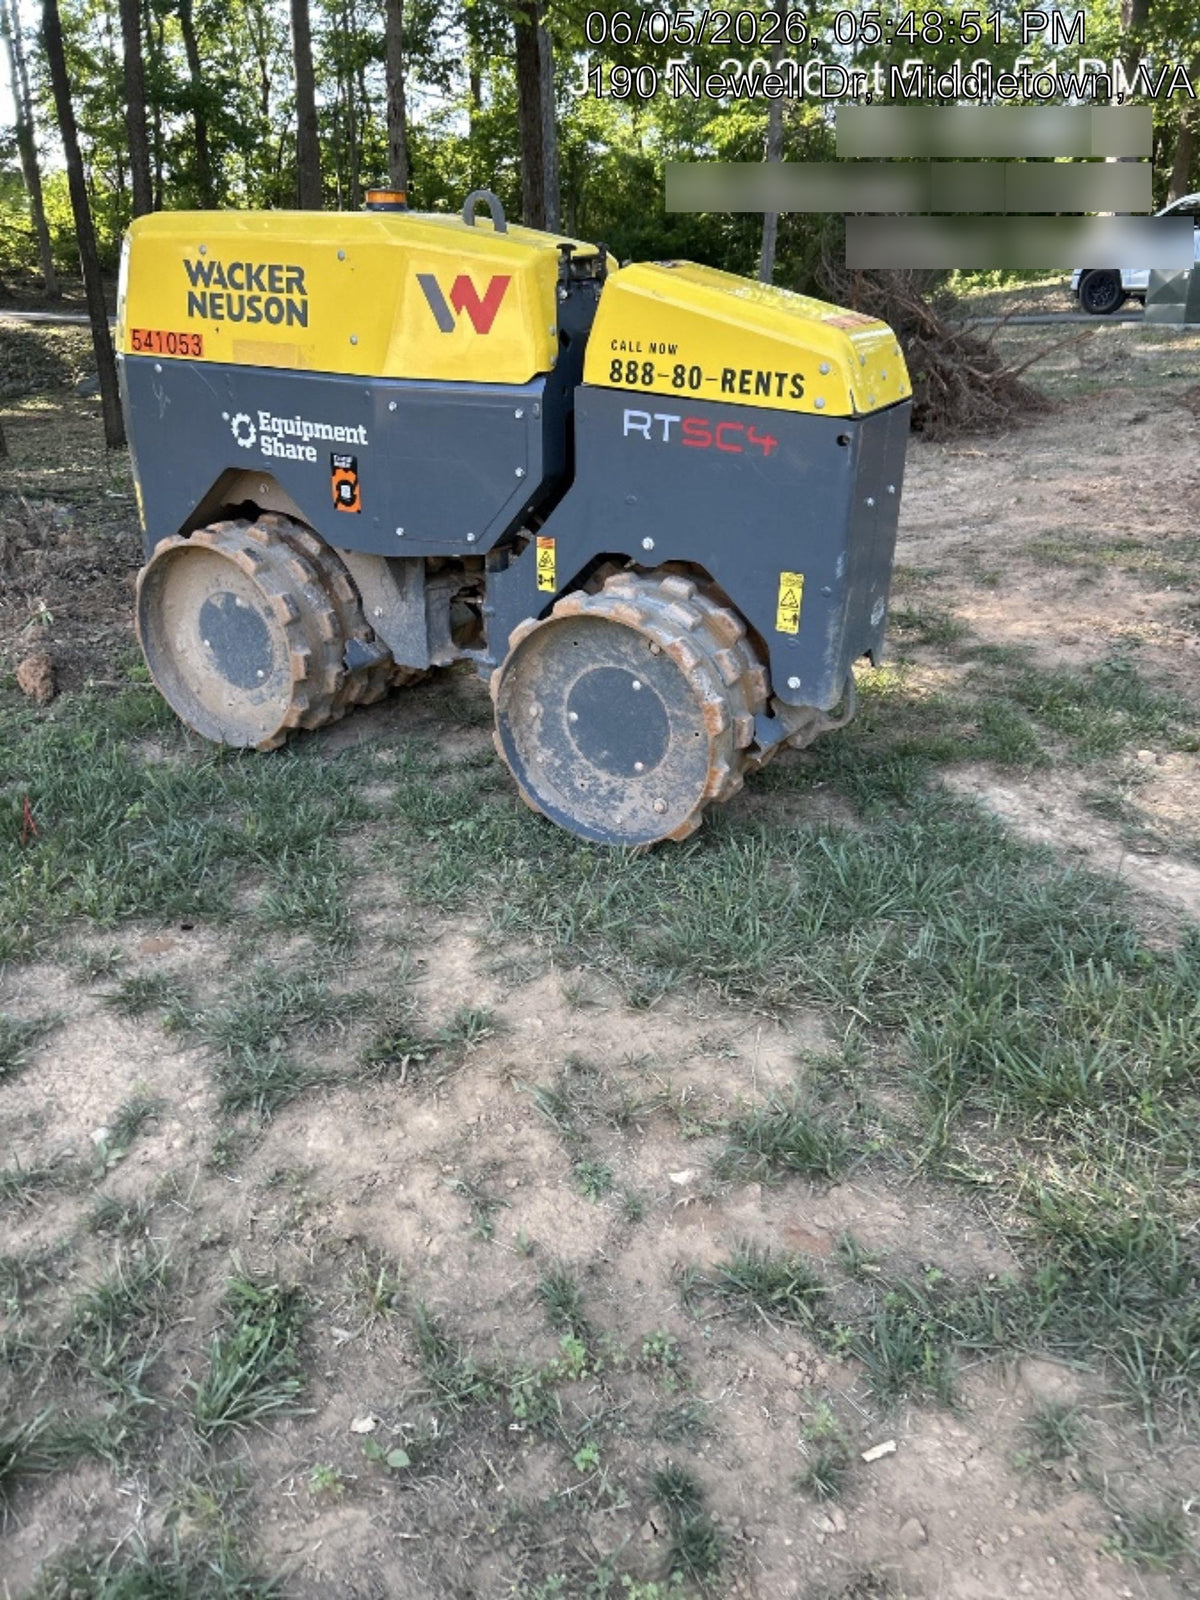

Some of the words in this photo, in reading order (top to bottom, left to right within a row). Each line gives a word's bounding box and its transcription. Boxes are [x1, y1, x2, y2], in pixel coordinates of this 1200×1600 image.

[183, 259, 308, 296] WACKER
[187, 291, 308, 328] NEUSON
[131, 329, 203, 357] 541053
[610, 339, 643, 353] CALL
[648, 342, 679, 355] NOW
[609, 359, 806, 399] 888-80-RENTS
[257, 410, 369, 446] Equipment
[623, 408, 779, 457] RTSC4
[260, 435, 318, 463] Share
